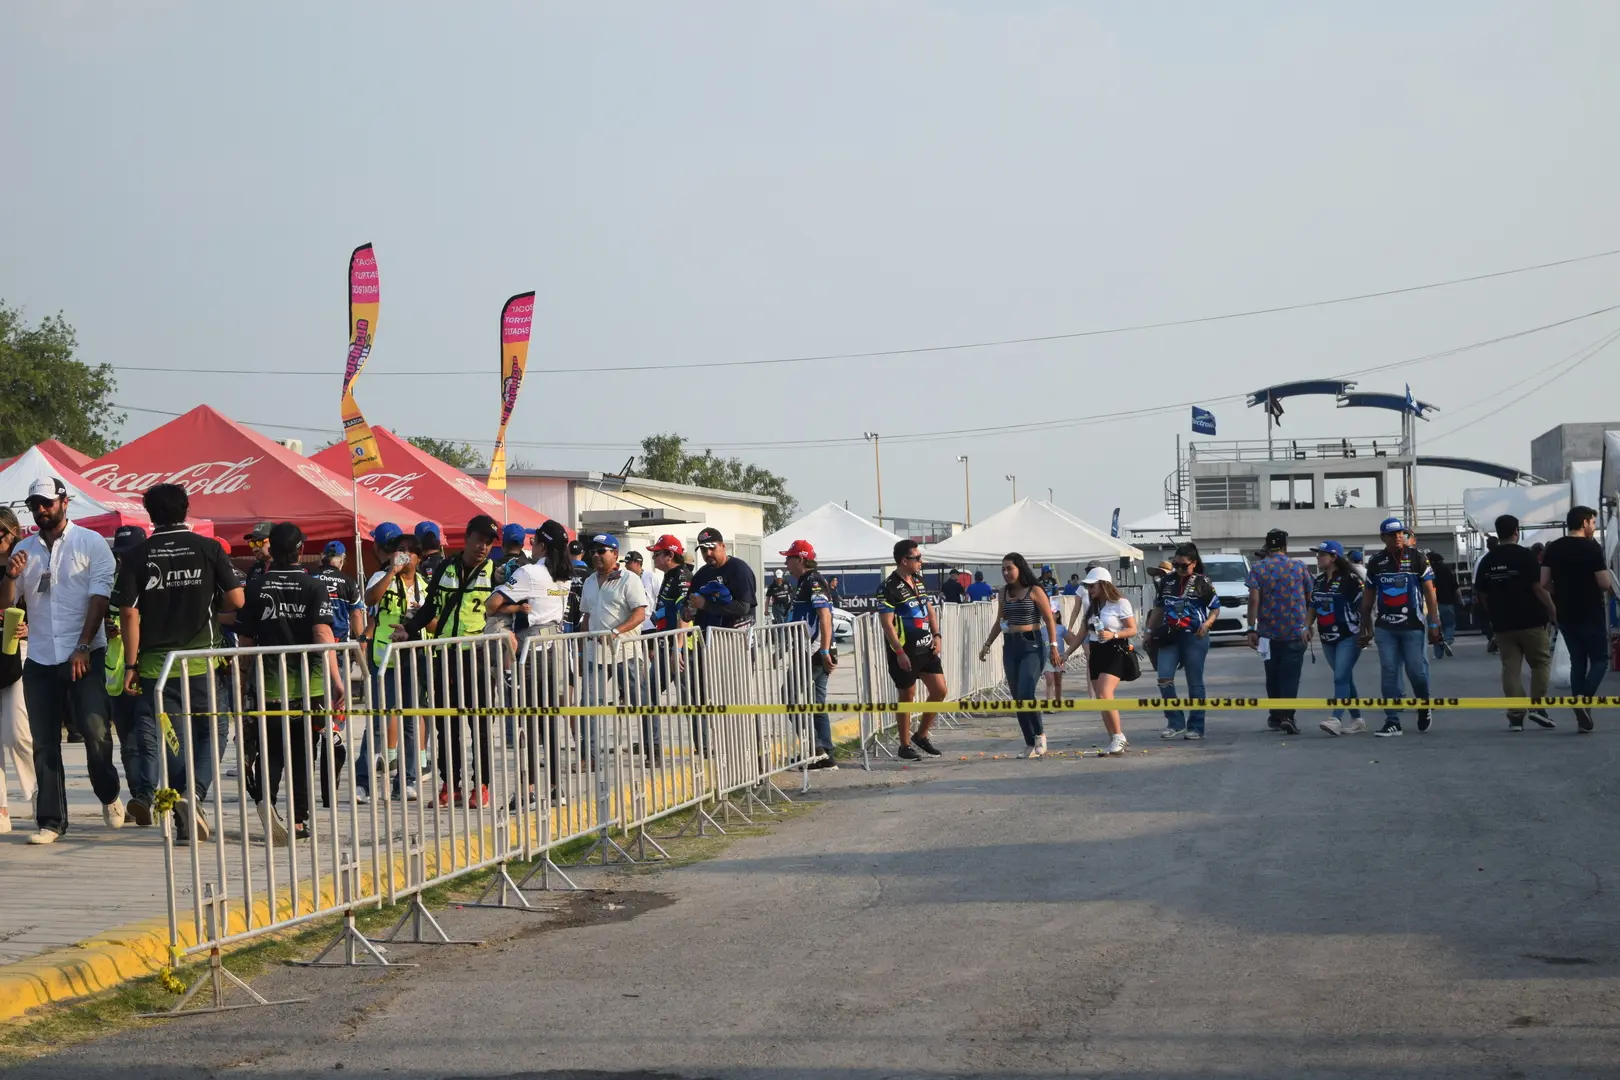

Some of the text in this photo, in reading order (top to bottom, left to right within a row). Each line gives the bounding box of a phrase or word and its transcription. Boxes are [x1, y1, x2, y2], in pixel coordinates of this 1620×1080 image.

[505, 315, 532, 324] TORTAS
[80, 455, 265, 496] Coca-Cola
[166, 579, 203, 588] MOTORSPORT
[319, 574, 346, 584] Chevron
[472, 598, 482, 612] 2
